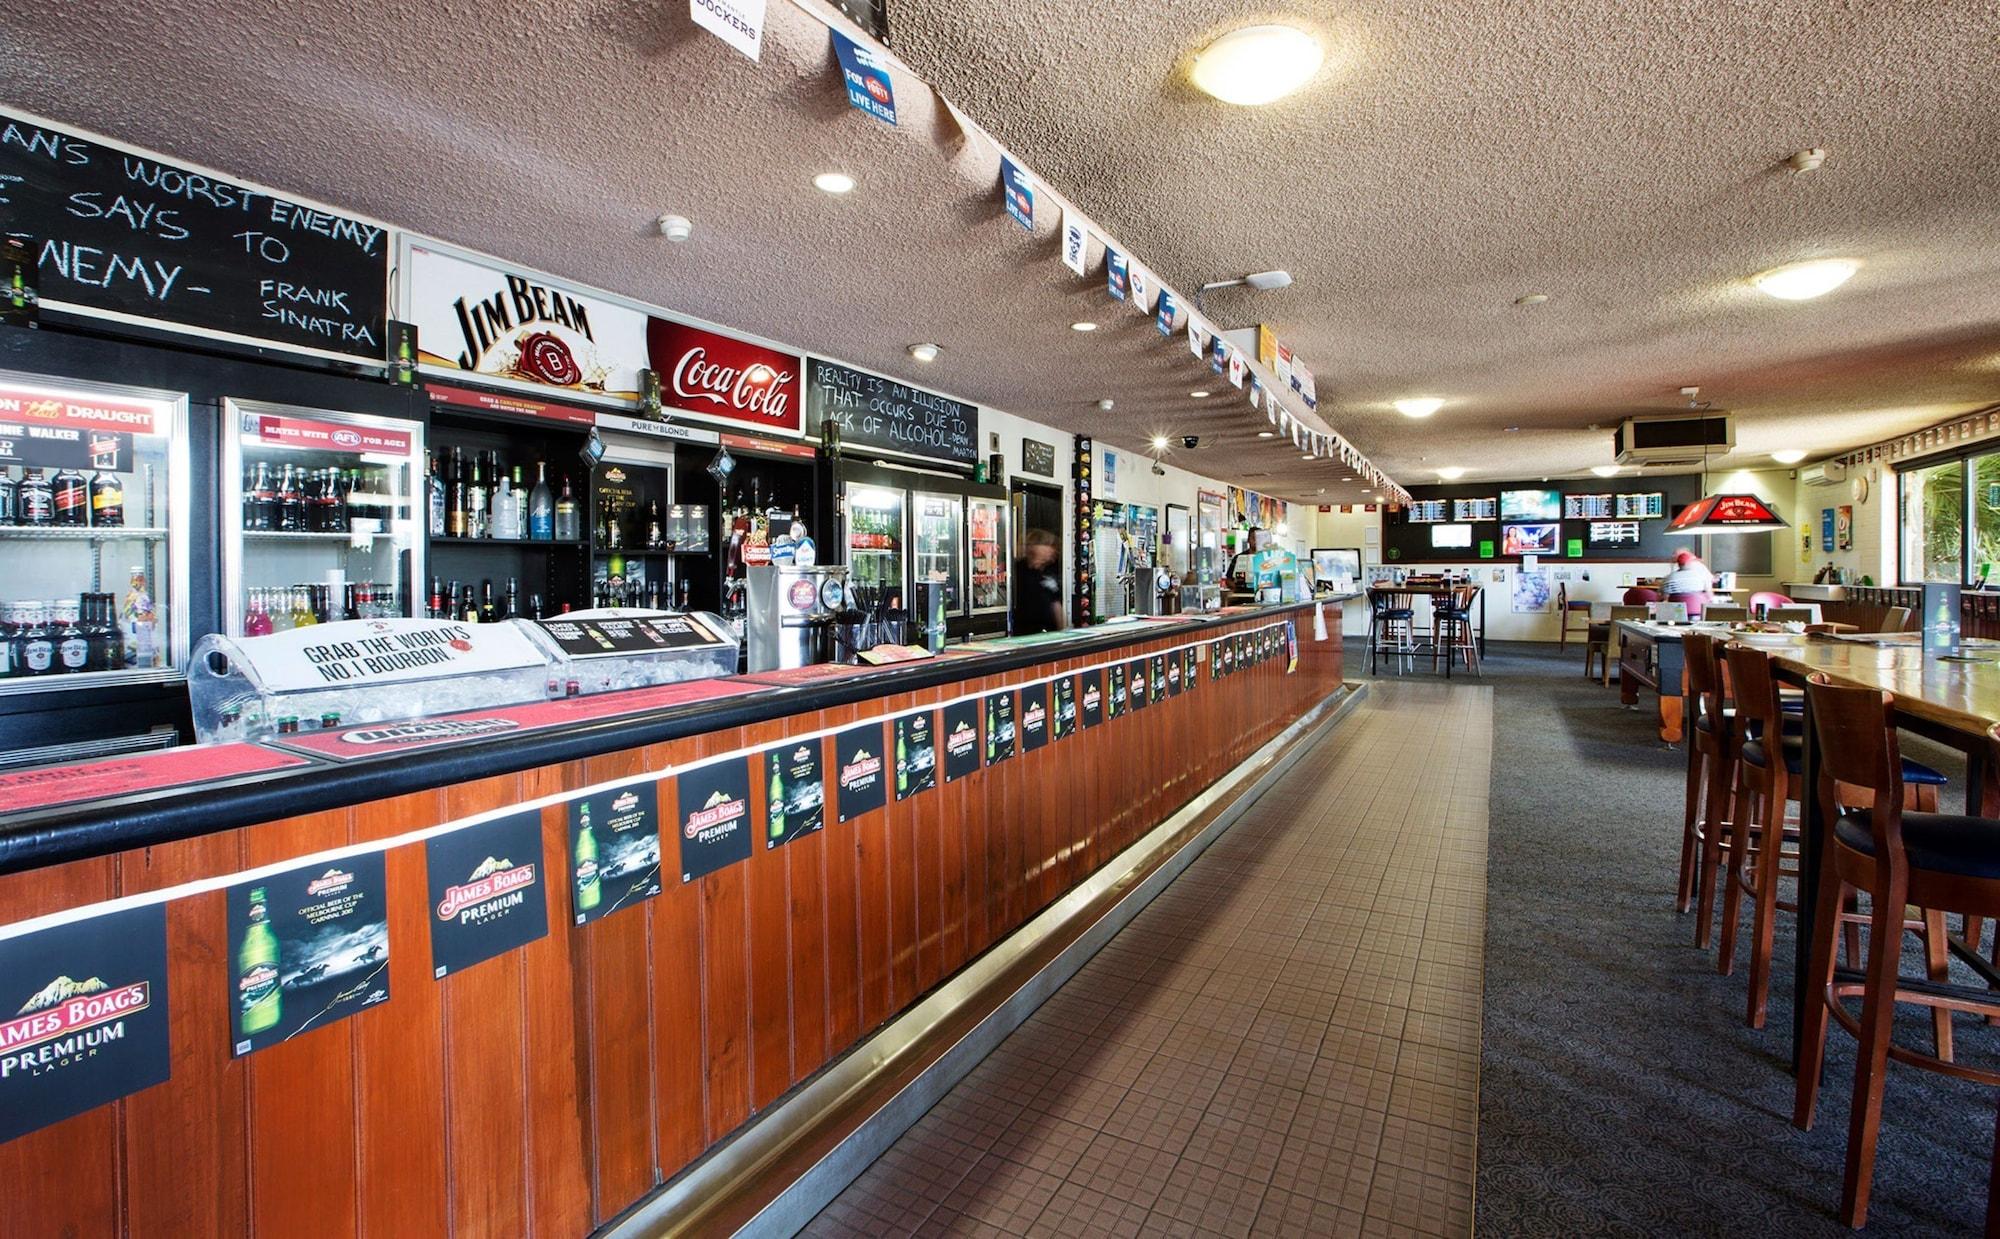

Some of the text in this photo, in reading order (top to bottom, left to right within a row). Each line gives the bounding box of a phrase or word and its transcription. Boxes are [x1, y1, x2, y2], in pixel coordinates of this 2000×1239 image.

[845, 68, 865, 89] FOX
[850, 89, 896, 123] LIVE HERE
[124, 157, 265, 212] WORST
[66, 192, 190, 240] SAYS
[233, 231, 289, 264] TO
[260, 280, 352, 314] FRANK
[262, 300, 376, 346] SINATRA
[453, 291, 513, 371] JIM
[505, 274, 595, 345] BEAM
[674, 347, 792, 418] Coca-Cola
[817, 366, 961, 418] REALITY IS AN ILLUSION
[66, 405, 152, 424] DRAUGHT
[822, 385, 967, 435] THAT OCCURS DUE TO
[863, 416, 883, 434] OF
[28, 426, 79, 440] WALKER
[301, 429, 329, 440] WITH
[334, 434, 358, 443] AFL
[363, 437, 382, 446] FOR
[384, 439, 406, 448] AGES
[632, 421, 690, 437] PURE BLONDE
[303, 640, 360, 663] GRAB
[357, 636, 397, 657] THE
[393, 626, 471, 652] WORLD'S
[687, 812, 717, 834] JAMES
[699, 819, 737, 843] PREMIUM
[298, 903, 326, 915] OFFICIAL
[327, 899, 342, 907] BEER
[440, 867, 532, 914] JAMES BOAG'S
[306, 900, 357, 919] MELBOURNE CUP
[461, 891, 523, 925] PREMIUM
[476, 909, 509, 925] LAGER
[68, 987, 144, 1025] BOAG'S
[1, 1021, 125, 1078] PREMIUM
[32, 1048, 97, 1077] LAGER
